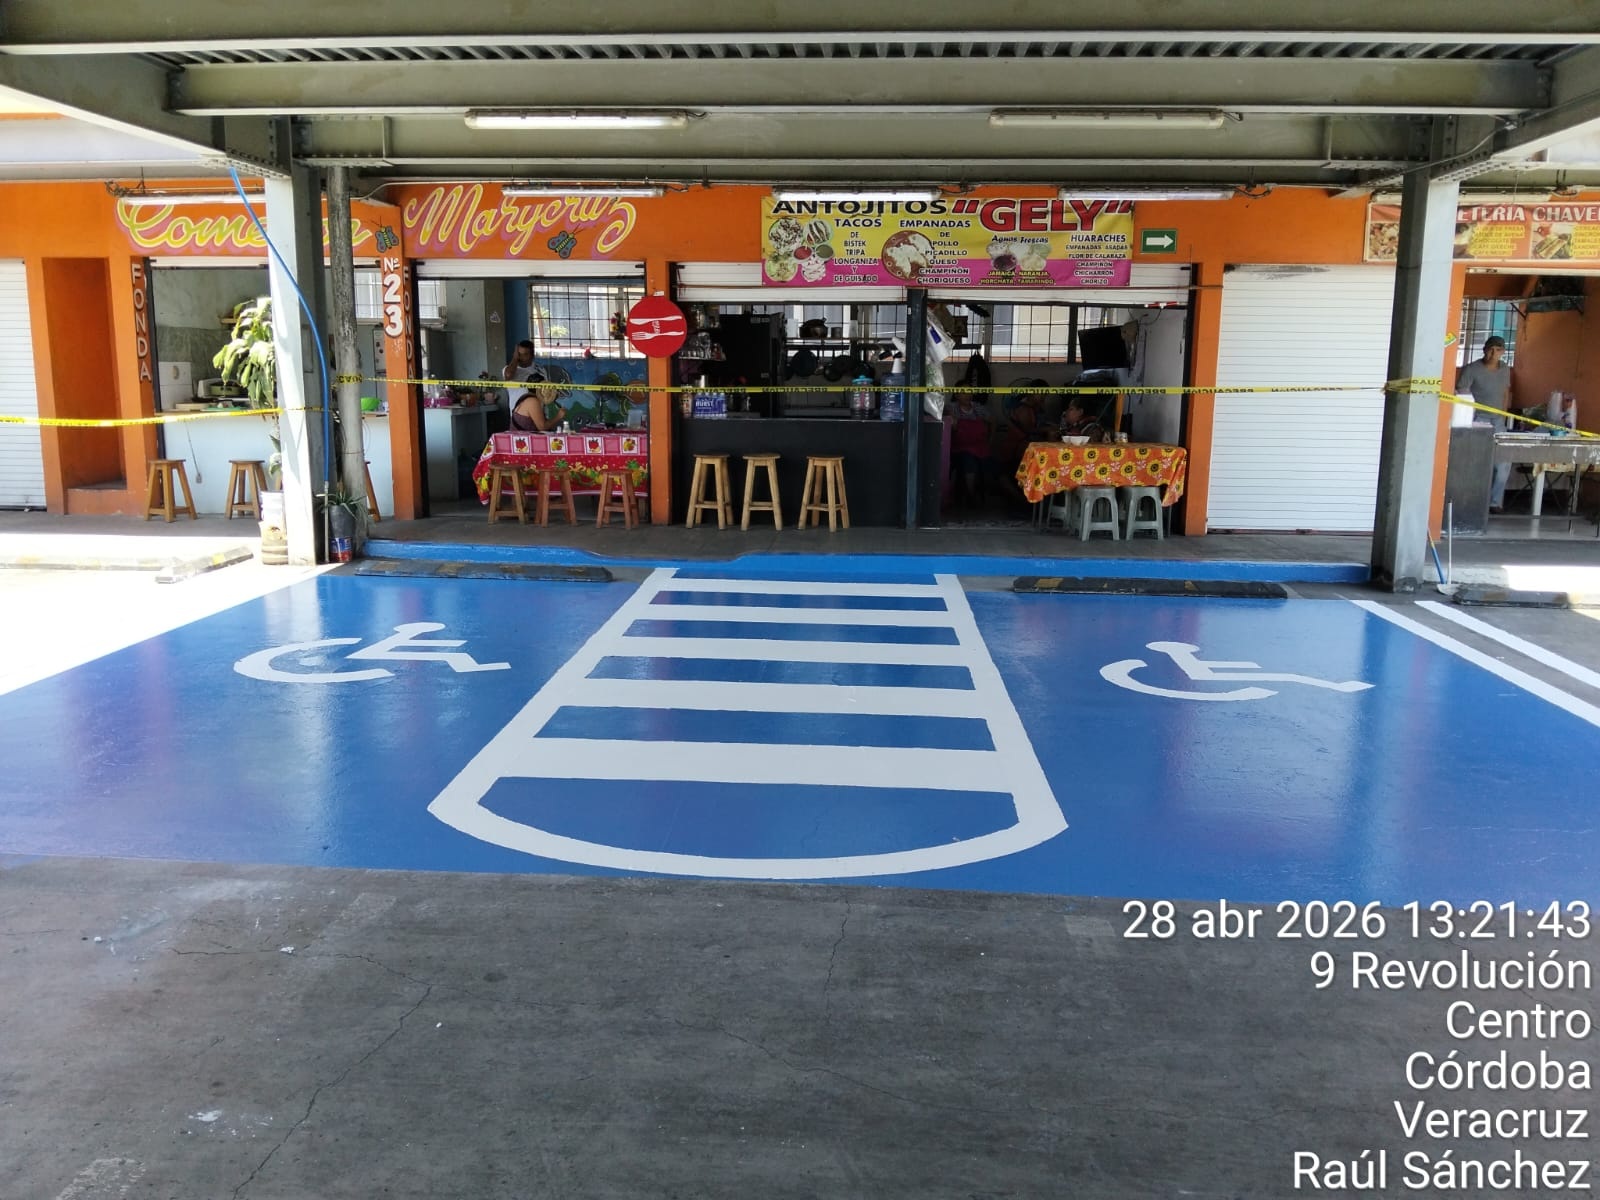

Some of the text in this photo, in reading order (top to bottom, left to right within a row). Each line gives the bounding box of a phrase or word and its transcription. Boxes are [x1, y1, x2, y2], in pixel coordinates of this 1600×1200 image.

[772, 200, 947, 214] ANTOJITOS
[1457, 206, 1600, 221] ETERIA CHAVE
[834, 218, 882, 228] TACOS
[900, 219, 971, 228] EMPANADAS
[1070, 234, 1126, 242] HUARACHES
[834, 257, 878, 265] LONGANIZA
[131, 263, 152, 382] FONDA
[403, 265, 416, 381] FONDA
